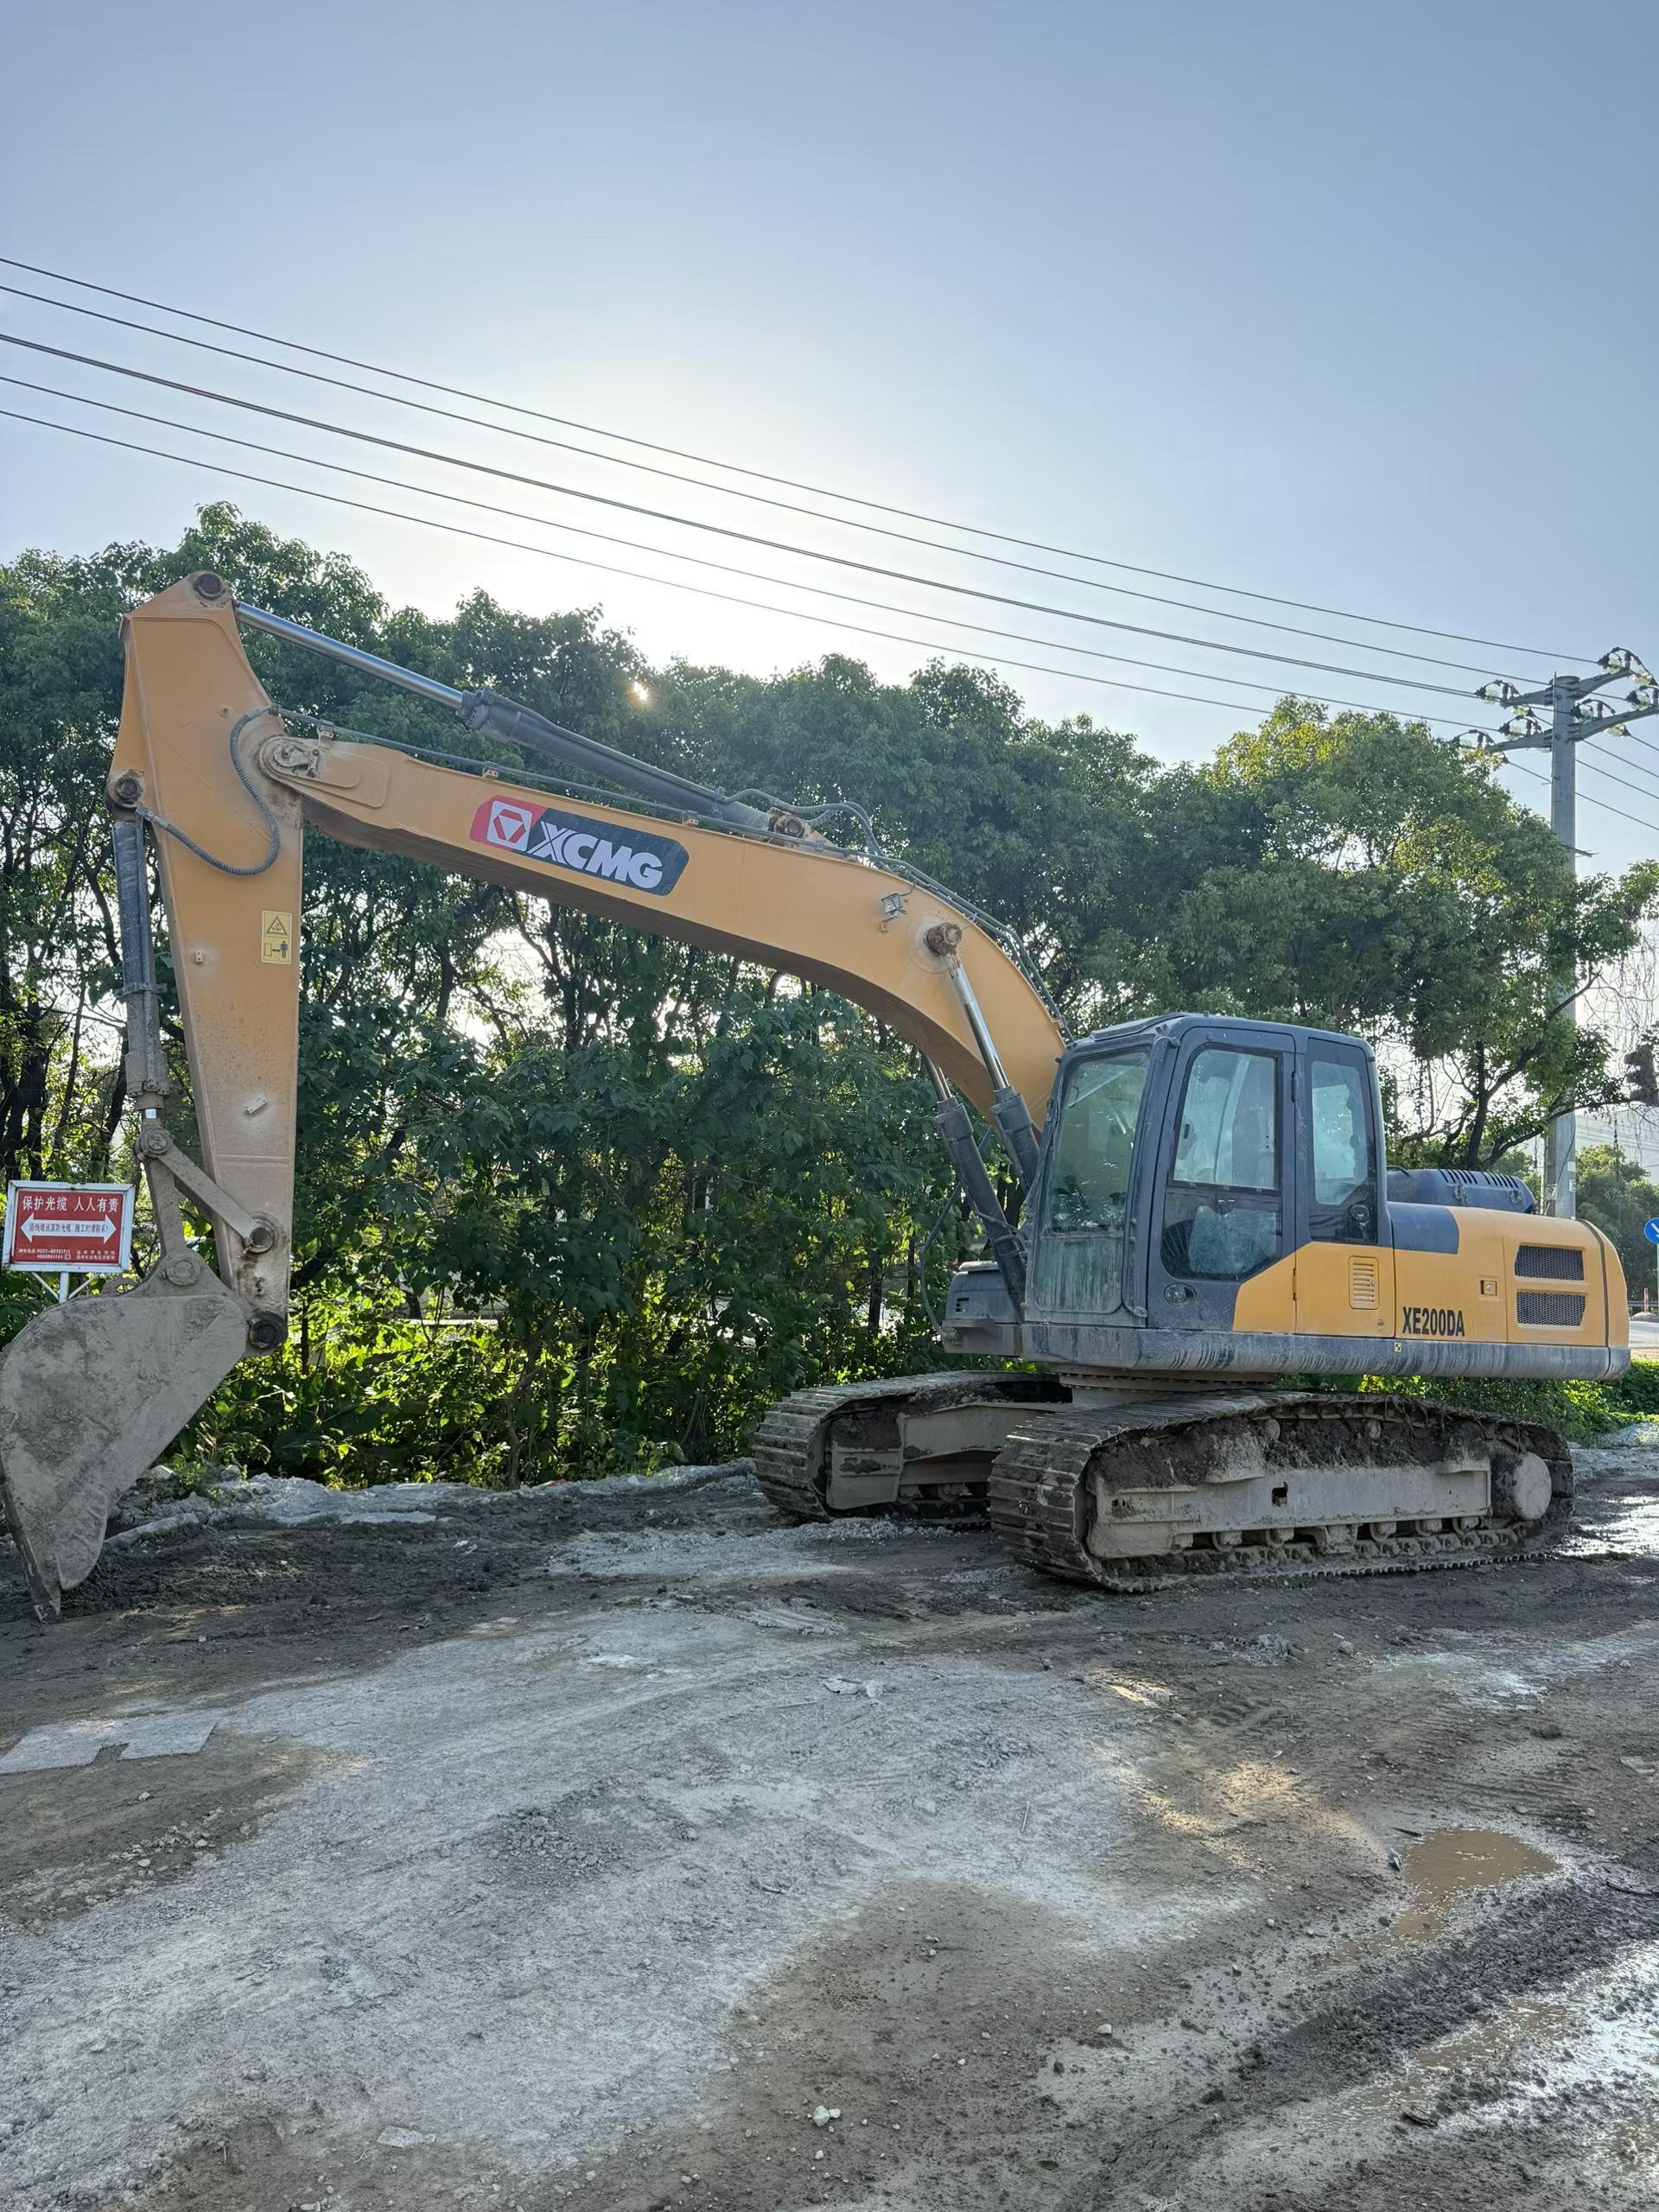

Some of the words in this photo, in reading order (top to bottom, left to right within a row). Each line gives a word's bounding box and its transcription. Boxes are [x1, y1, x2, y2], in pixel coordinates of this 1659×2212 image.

[527, 821, 663, 889] XCMG
[22, 1195, 68, 1211] 保护光缆
[73, 1197, 119, 1213] 人人有责
[1402, 1306, 1465, 1337] XE200DA
